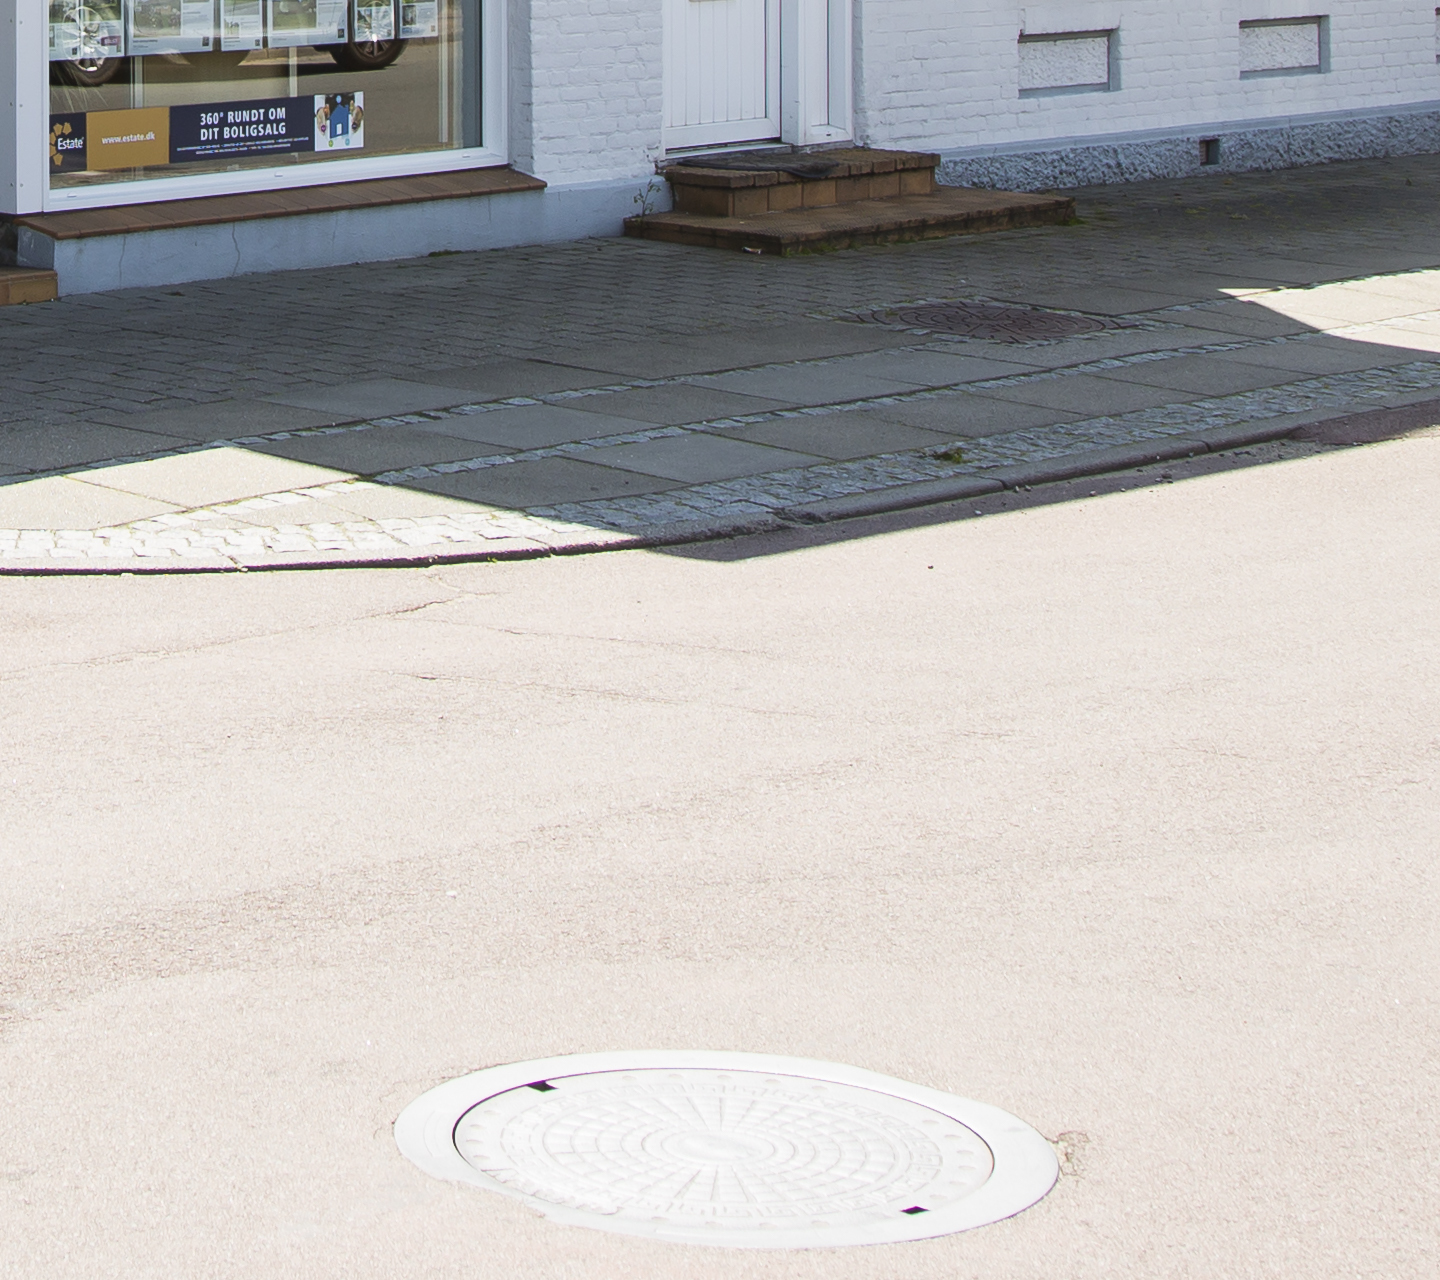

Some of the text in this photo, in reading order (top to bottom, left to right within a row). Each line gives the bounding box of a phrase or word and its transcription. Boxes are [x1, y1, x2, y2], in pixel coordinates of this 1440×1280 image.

[200, 107, 286, 126] 360° RUNDT OM
[102, 131, 155, 145] www.estate.dk
[200, 122, 286, 141] DIT BOLIGSALG
[57, 138, 83, 150] Estate
